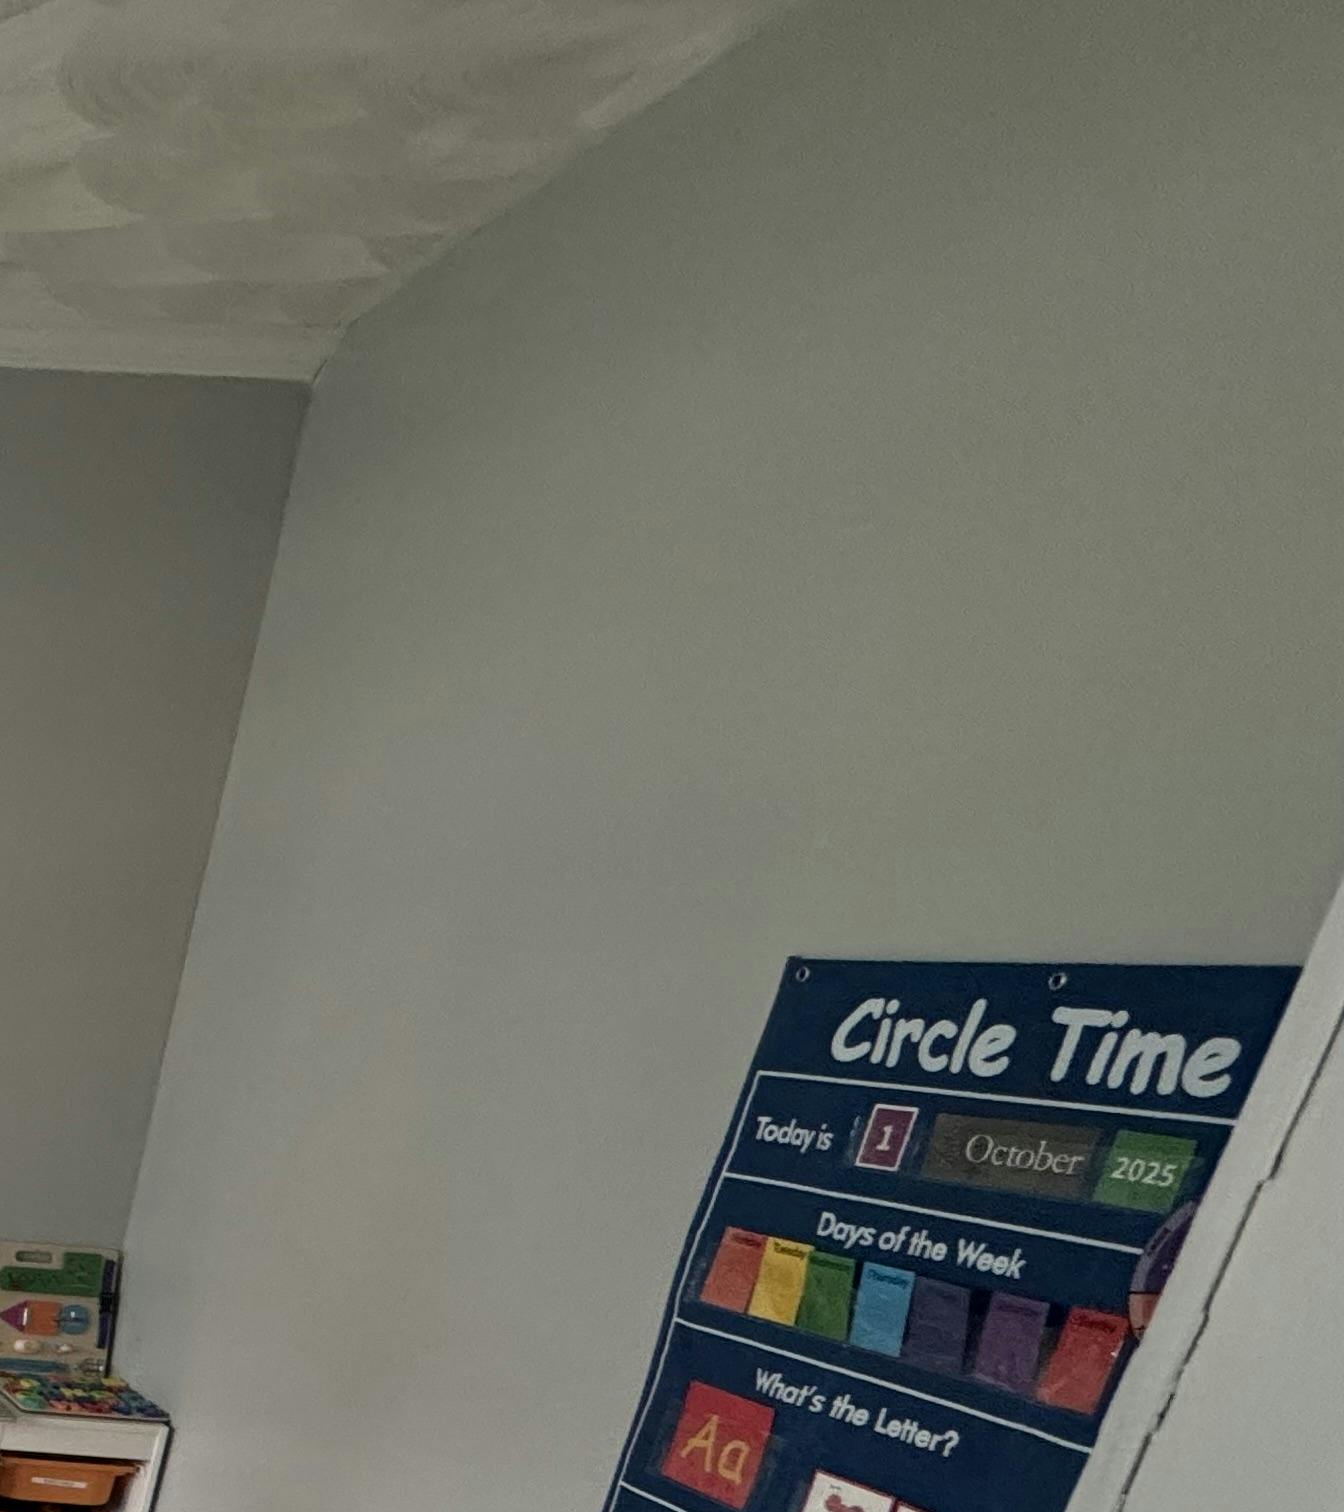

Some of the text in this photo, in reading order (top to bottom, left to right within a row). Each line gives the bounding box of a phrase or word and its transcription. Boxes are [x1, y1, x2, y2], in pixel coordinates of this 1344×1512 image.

[831, 998, 1242, 1098] Circle Time
[755, 1116, 833, 1153] Today is
[874, 1125, 892, 1152] 1
[964, 1131, 1086, 1178] October
[1109, 1155, 1177, 1187] 2025
[816, 1211, 1026, 1281] Days of the Week
[755, 1366, 961, 1458] What's the Letter?
[680, 1415, 750, 1486] Aa
